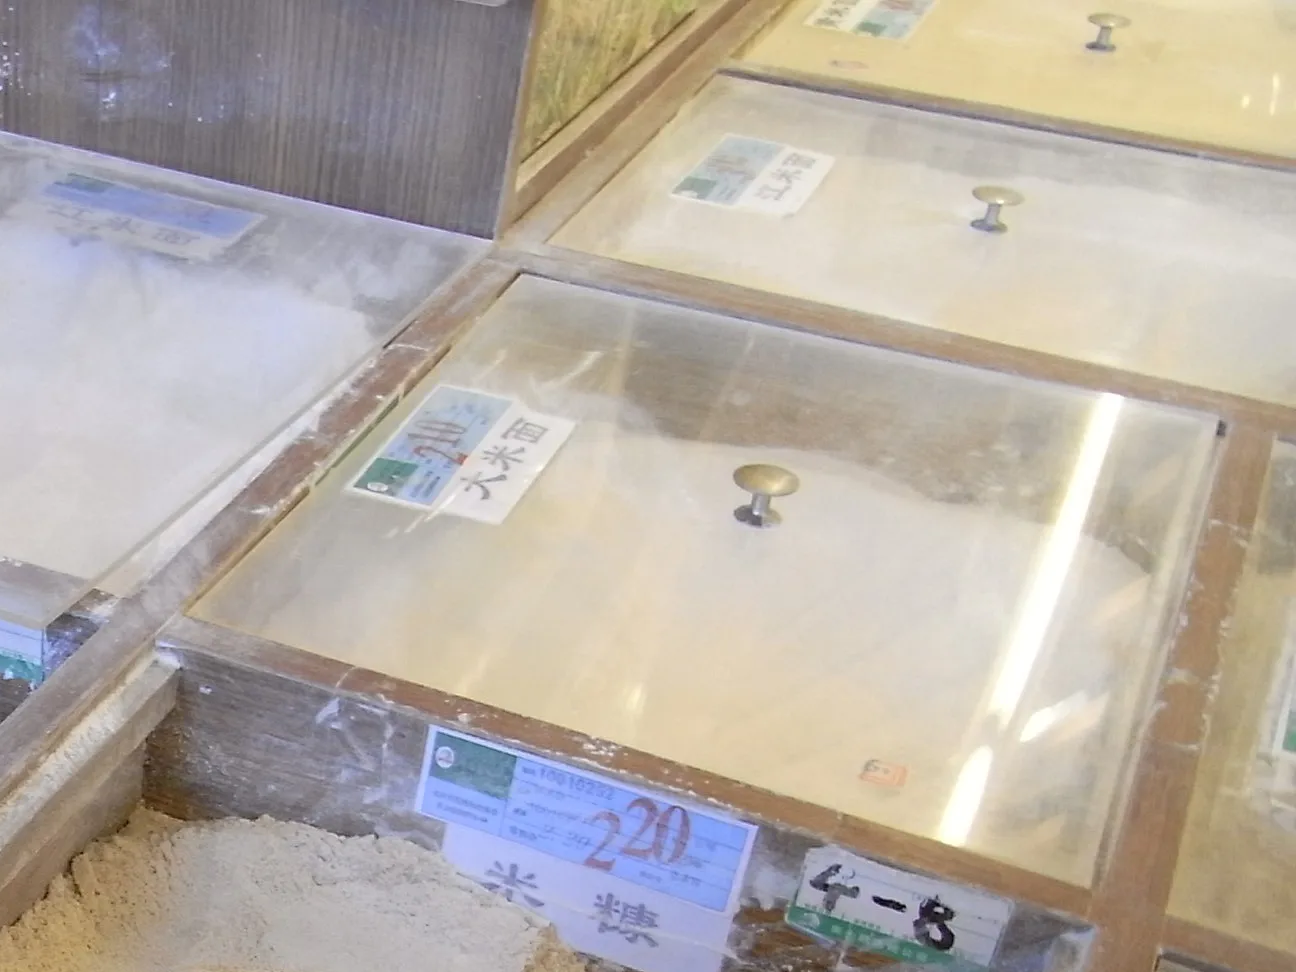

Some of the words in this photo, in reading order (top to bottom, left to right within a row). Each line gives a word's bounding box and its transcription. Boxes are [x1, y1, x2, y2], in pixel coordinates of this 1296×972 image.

[407, 419, 469, 466] 210
[461, 417, 549, 501] 大米面
[584, 797, 690, 872] 220
[479, 860, 660, 948] 米糠
[808, 862, 956, 951] 4-8
